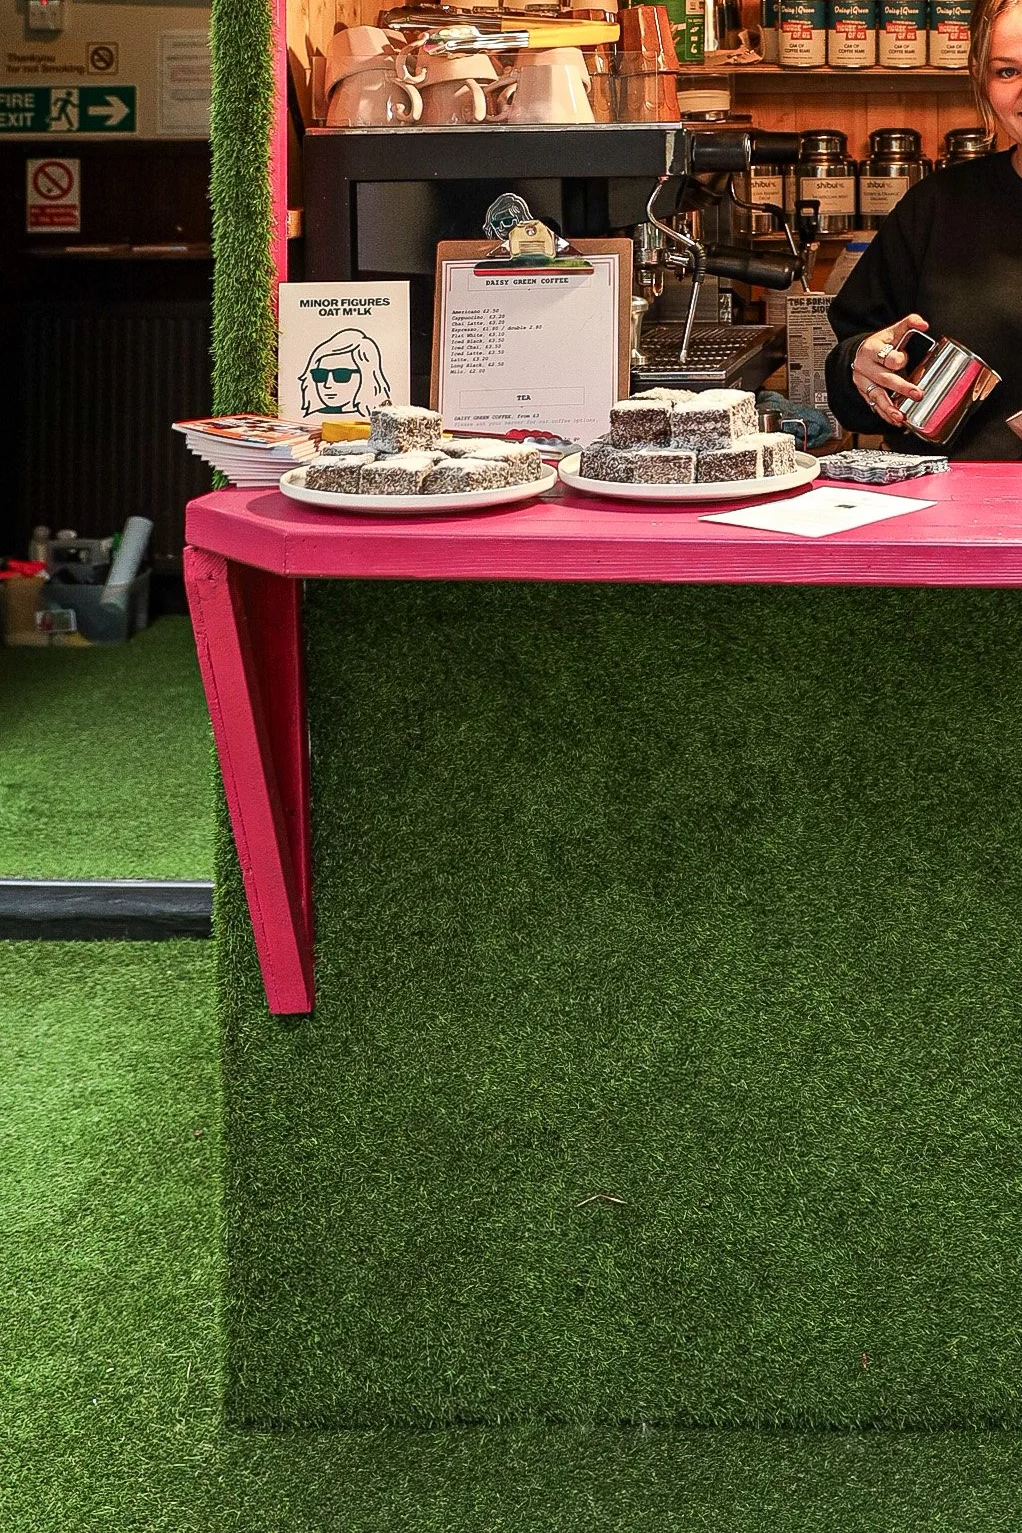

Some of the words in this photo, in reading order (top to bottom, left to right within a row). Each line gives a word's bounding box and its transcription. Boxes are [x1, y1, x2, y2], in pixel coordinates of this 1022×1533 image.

[0, 93, 35, 107] FIRE
[0, 112, 34, 127] EXIT
[817, 181, 837, 189] shibui
[300, 299, 338, 307] MINOR
[341, 298, 390, 306] FIGURES
[806, 297, 833, 305] BORIN
[319, 308, 340, 316] OAT
